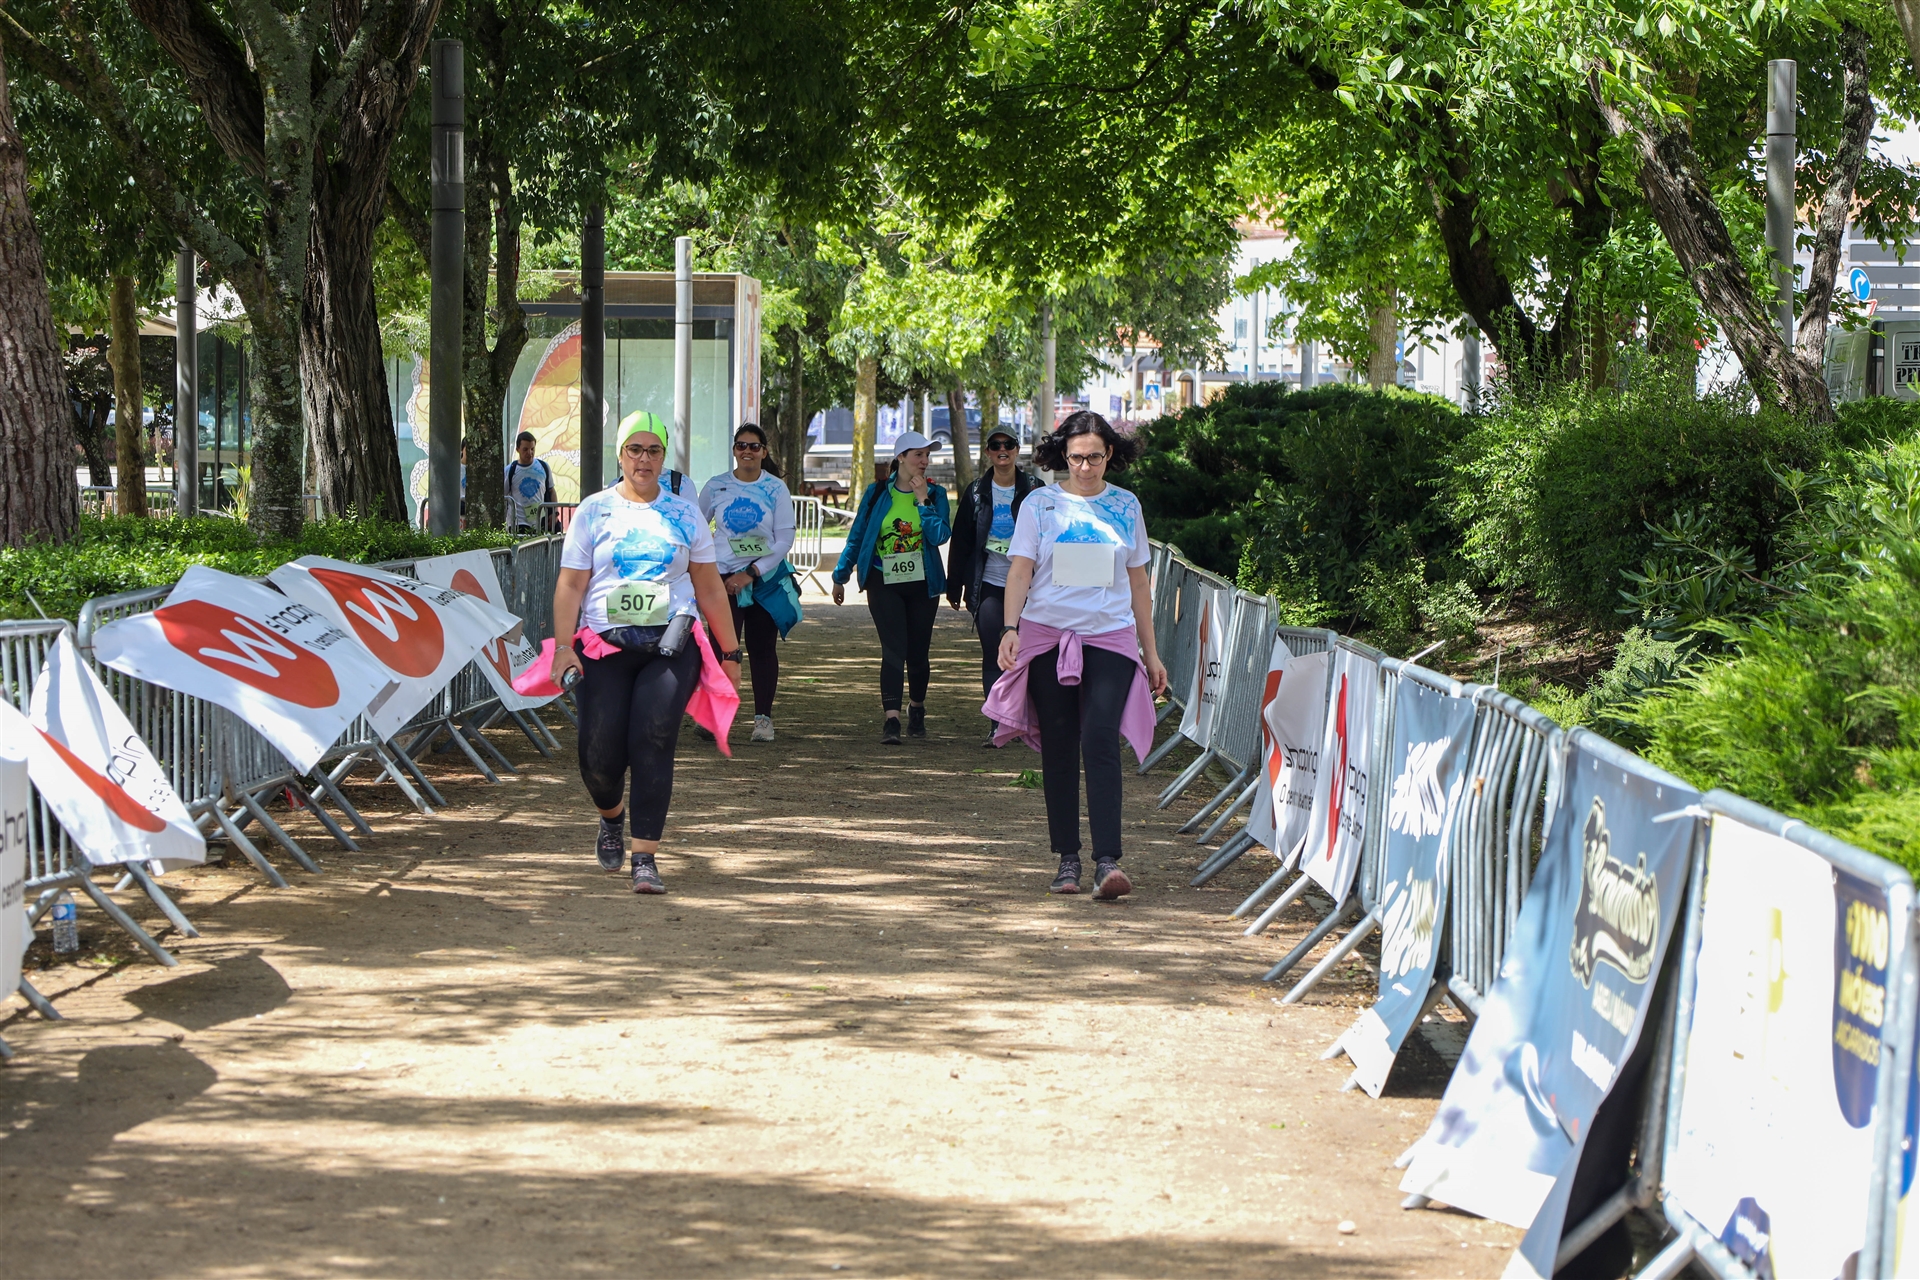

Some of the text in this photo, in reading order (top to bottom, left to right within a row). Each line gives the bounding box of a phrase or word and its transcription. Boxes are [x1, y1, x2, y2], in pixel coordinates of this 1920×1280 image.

[739, 544, 763, 552] 515
[891, 560, 916, 574] 469
[620, 594, 657, 611] 507
